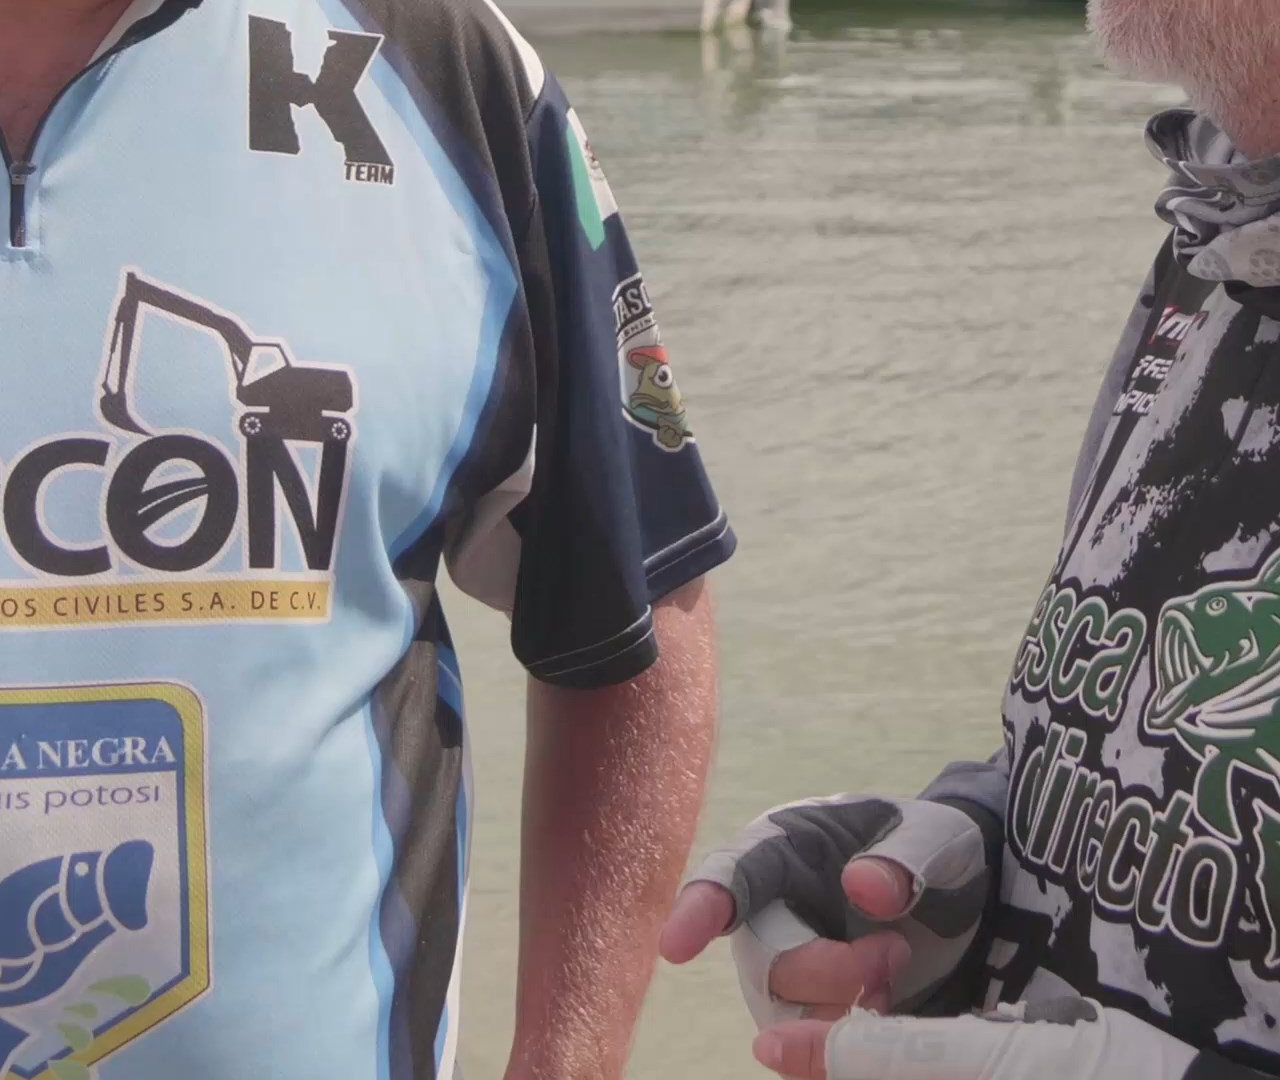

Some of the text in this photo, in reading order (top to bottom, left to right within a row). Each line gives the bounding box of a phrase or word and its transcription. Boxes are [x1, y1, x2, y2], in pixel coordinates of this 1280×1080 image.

[248, 14, 394, 166] K
[344, 163, 394, 186] TEAM
[52, 592, 166, 617] CIVILES
[181, 591, 237, 612] S.A.
[251, 590, 280, 610] DE
[289, 591, 321, 610] C.V.
[35, 734, 177, 770] NEGRA
[1012, 722, 1238, 948] directo
